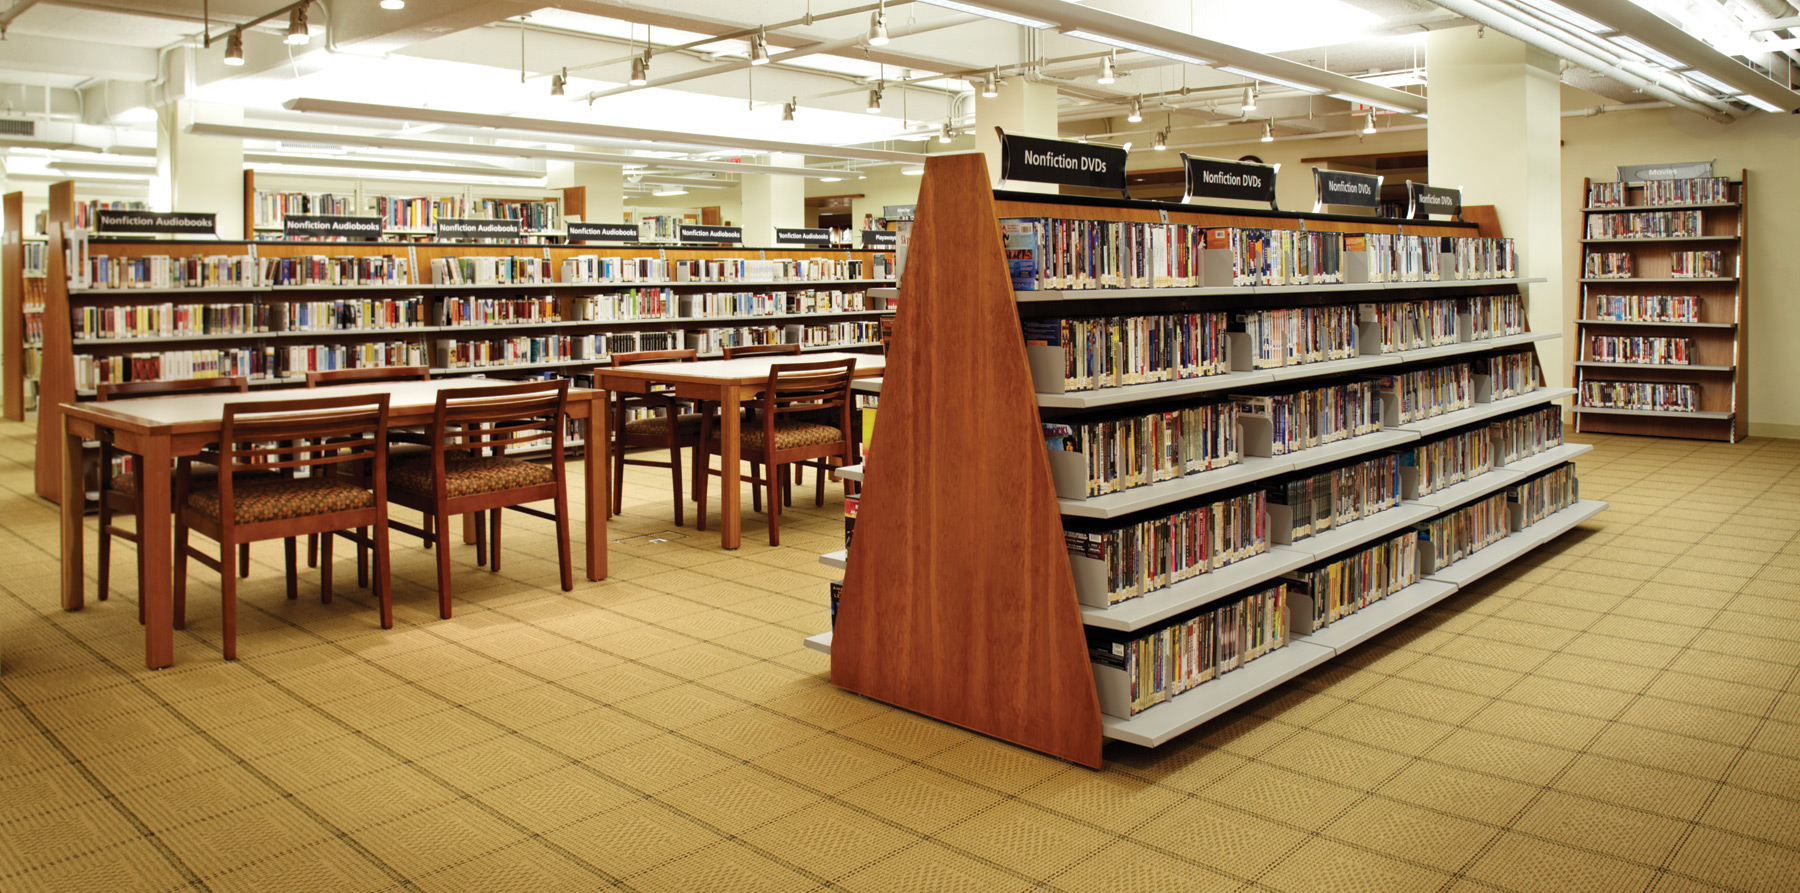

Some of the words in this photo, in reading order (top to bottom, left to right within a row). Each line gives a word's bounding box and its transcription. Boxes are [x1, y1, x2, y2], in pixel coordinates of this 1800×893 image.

[1024, 149, 1078, 170] Nonfiction
[1080, 156, 1107, 173] DVDs
[1648, 168, 1678, 176] Movies
[1203, 170, 1241, 186] Nonfiction
[1242, 174, 1262, 188] DVDs
[1328, 180, 1358, 194] Nonfiction
[1357, 182, 1372, 195] DVDs
[1418, 193, 1441, 205] Nonfiction
[1440, 195, 1453, 206] DVDs
[101, 215, 153, 226] Nonfiction
[154, 216, 213, 227] Audiobooks
[286, 220, 331, 230] Nonfiction
[331, 221, 380, 231] Audiobooks
[439, 223, 477, 232] Nonfiction
[477, 223, 518, 233] Audiobooks
[569, 227, 601, 235] Nonfiction
[601, 228, 637, 237] Audiobooks
[681, 229, 710, 237] Nonfiction
[709, 230, 741, 238] Audiobooks
[802, 232, 829, 240] Audiobooks
